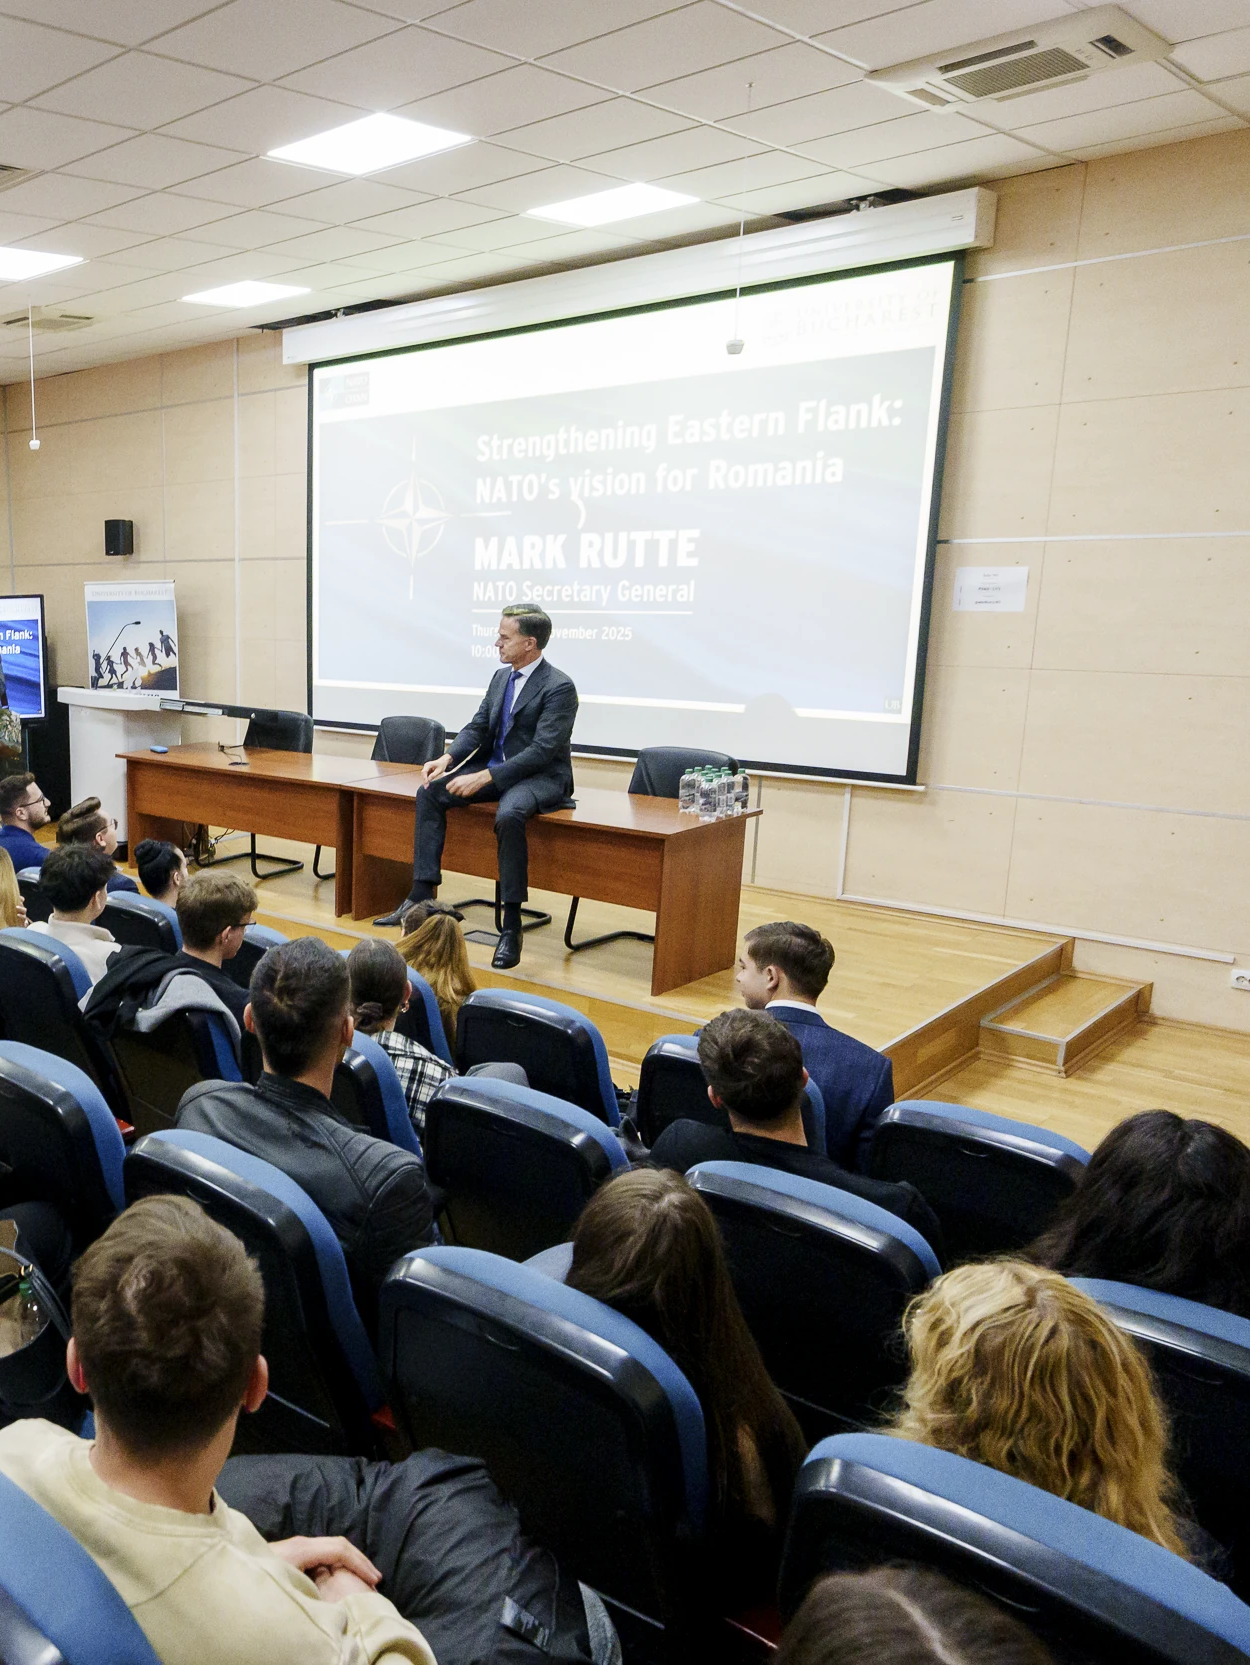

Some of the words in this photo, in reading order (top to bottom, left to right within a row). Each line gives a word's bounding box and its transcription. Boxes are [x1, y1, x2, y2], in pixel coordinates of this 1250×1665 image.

[796, 301, 940, 337] BUCHAREST
[476, 420, 657, 463] Strengthening
[667, 408, 786, 445] Eastern
[797, 393, 904, 434] Flank:
[475, 473, 560, 504] NATO's
[568, 465, 647, 500] vision
[654, 462, 699, 494] for
[707, 450, 844, 491] Romania
[473, 534, 568, 571] MARK
[579, 528, 701, 569] RUTTE
[472, 581, 518, 602] NATO
[522, 580, 611, 606] Secretary
[617, 579, 696, 603] General
[5, 629, 34, 641] Flank:
[471, 623, 500, 638] Thurs
[550, 626, 598, 641] ovember
[601, 626, 633, 641] 2025
